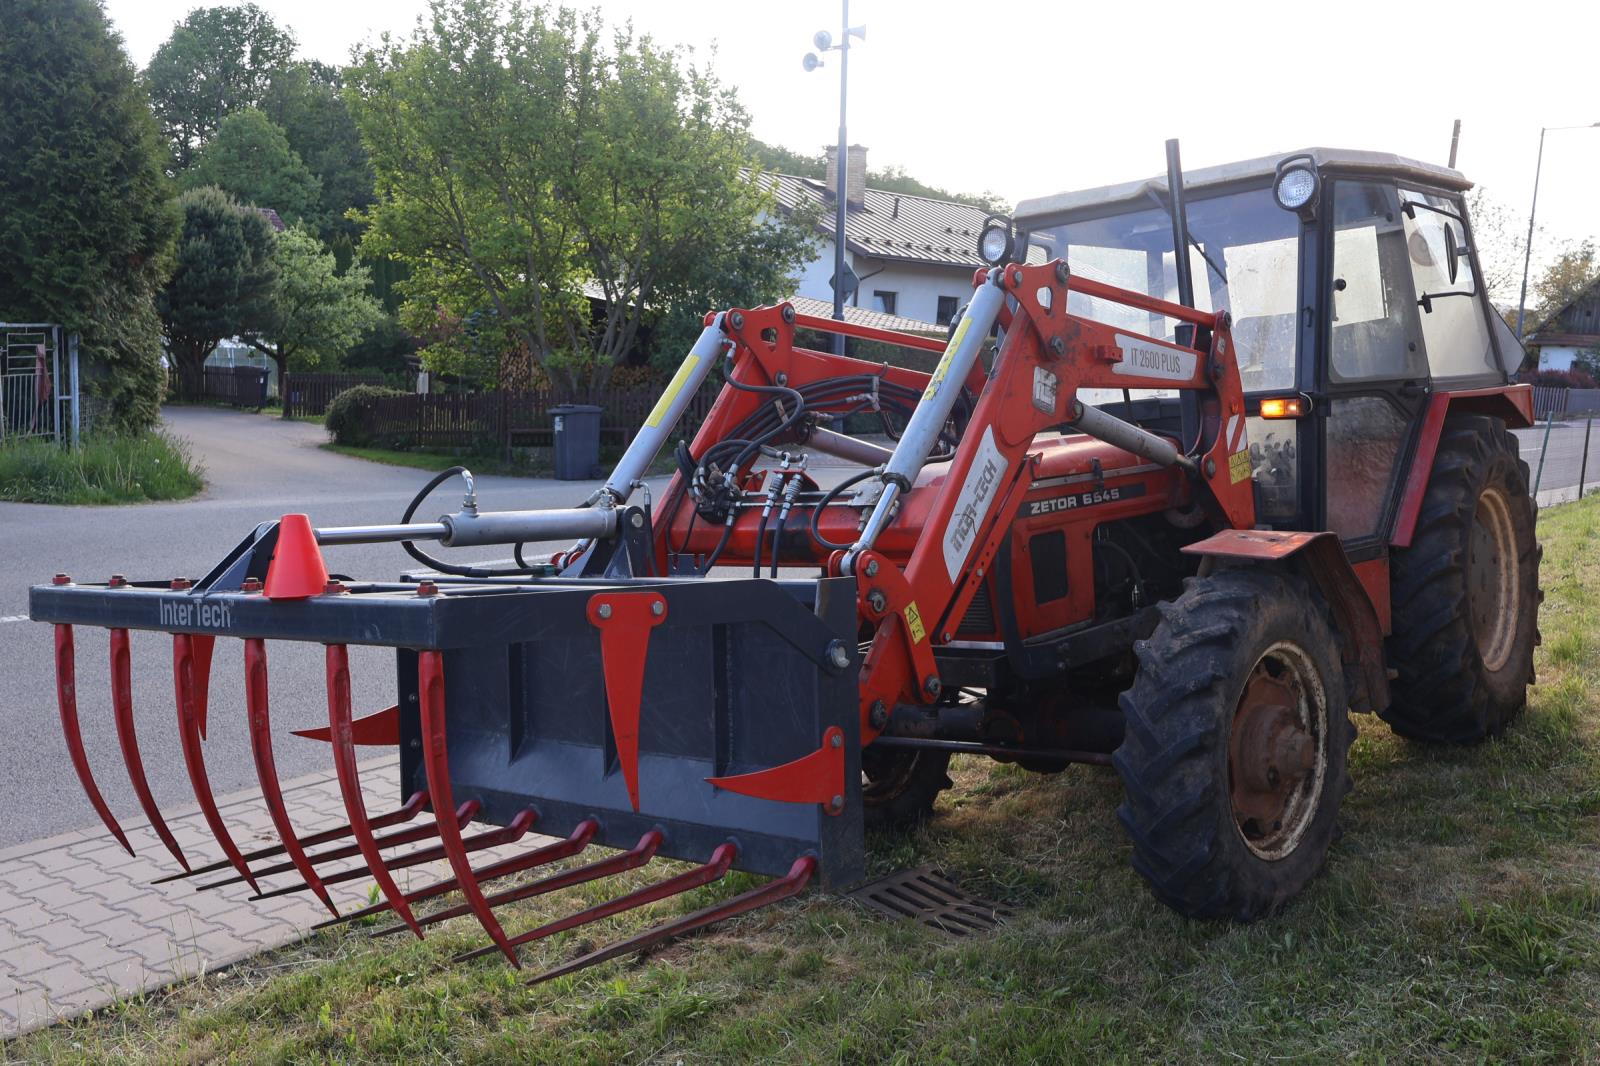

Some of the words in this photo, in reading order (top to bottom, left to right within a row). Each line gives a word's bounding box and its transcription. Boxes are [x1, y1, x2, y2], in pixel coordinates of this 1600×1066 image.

[1131, 348, 1139, 366] IT
[1140, 350, 1160, 370] 2600
[1161, 353, 1181, 373] PLUS
[1030, 496, 1077, 514] ZETOR
